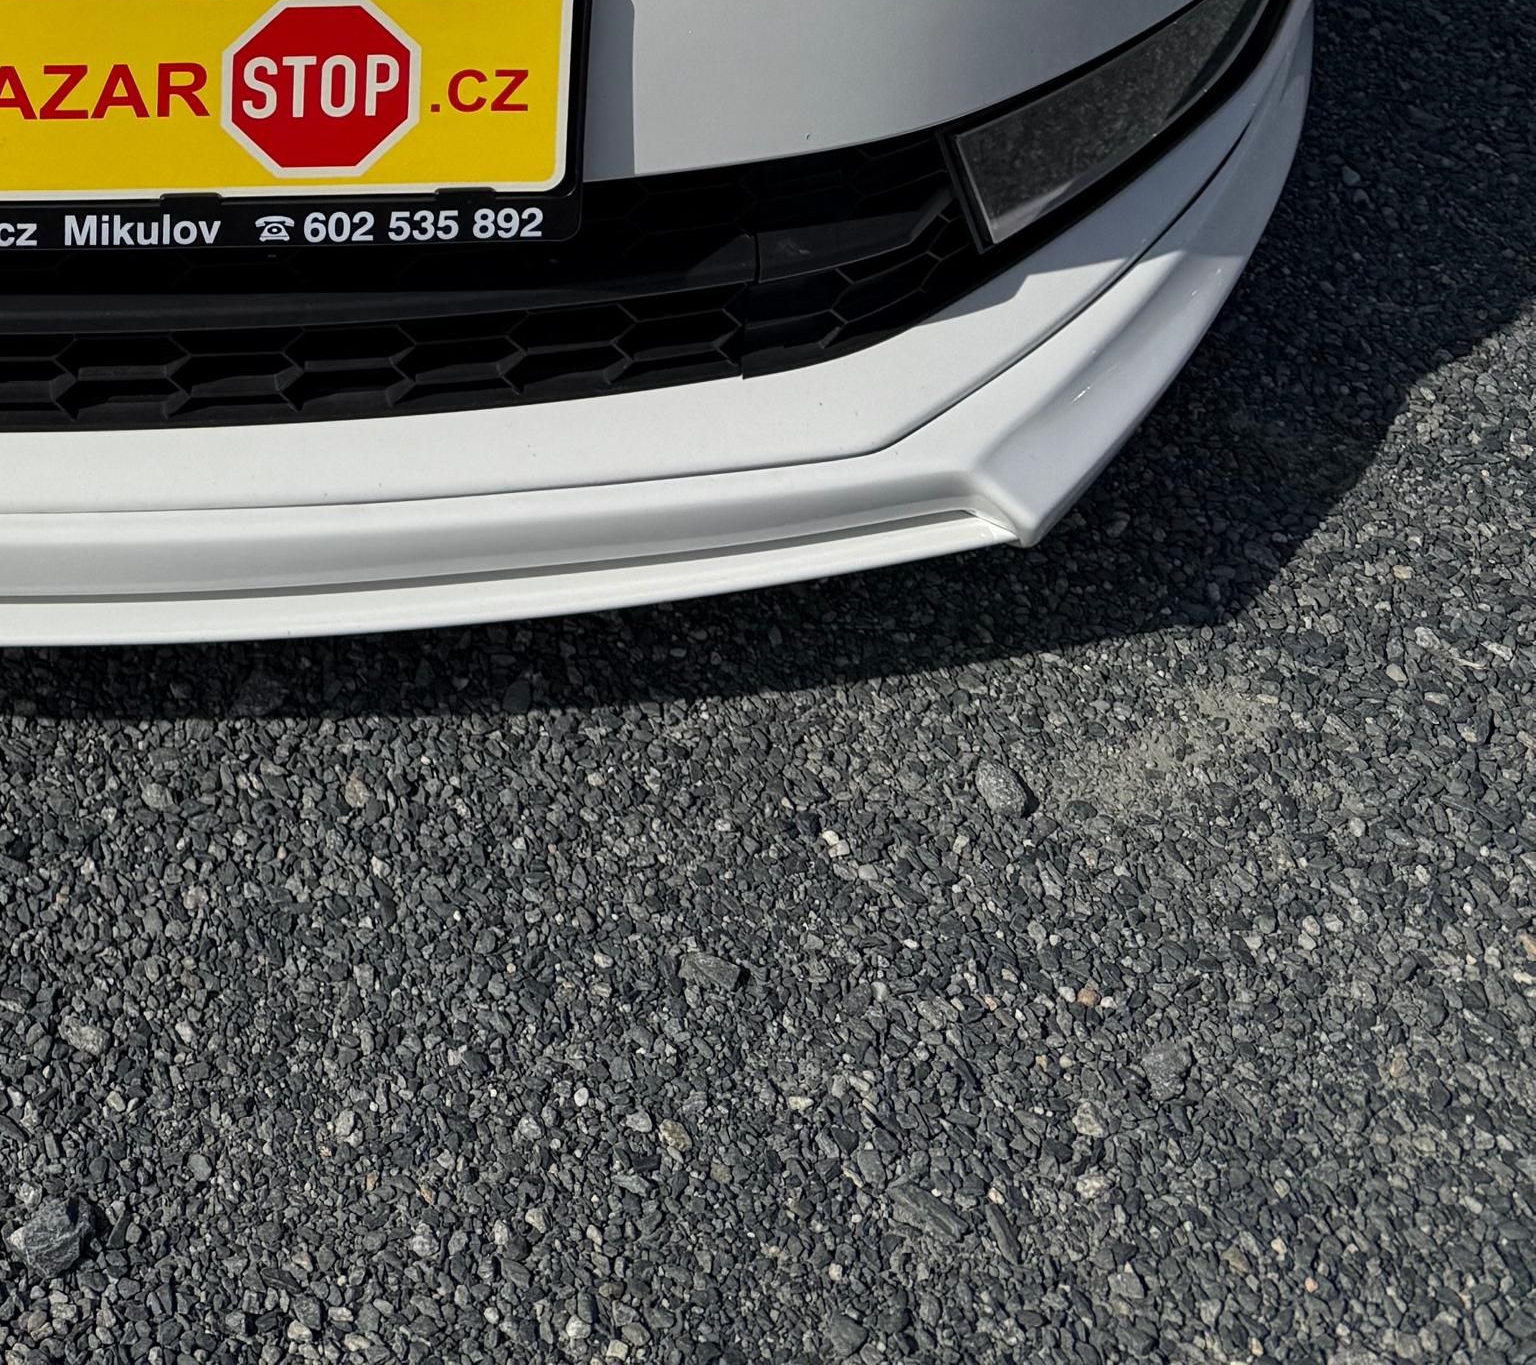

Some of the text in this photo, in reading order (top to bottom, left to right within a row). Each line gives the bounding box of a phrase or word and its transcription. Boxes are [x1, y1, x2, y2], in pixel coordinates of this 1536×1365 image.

[241, 53, 401, 120] STOP
[64, 213, 222, 246] Mikulov
[303, 211, 374, 244] 602
[387, 210, 460, 242] 535
[472, 207, 544, 239] 892
